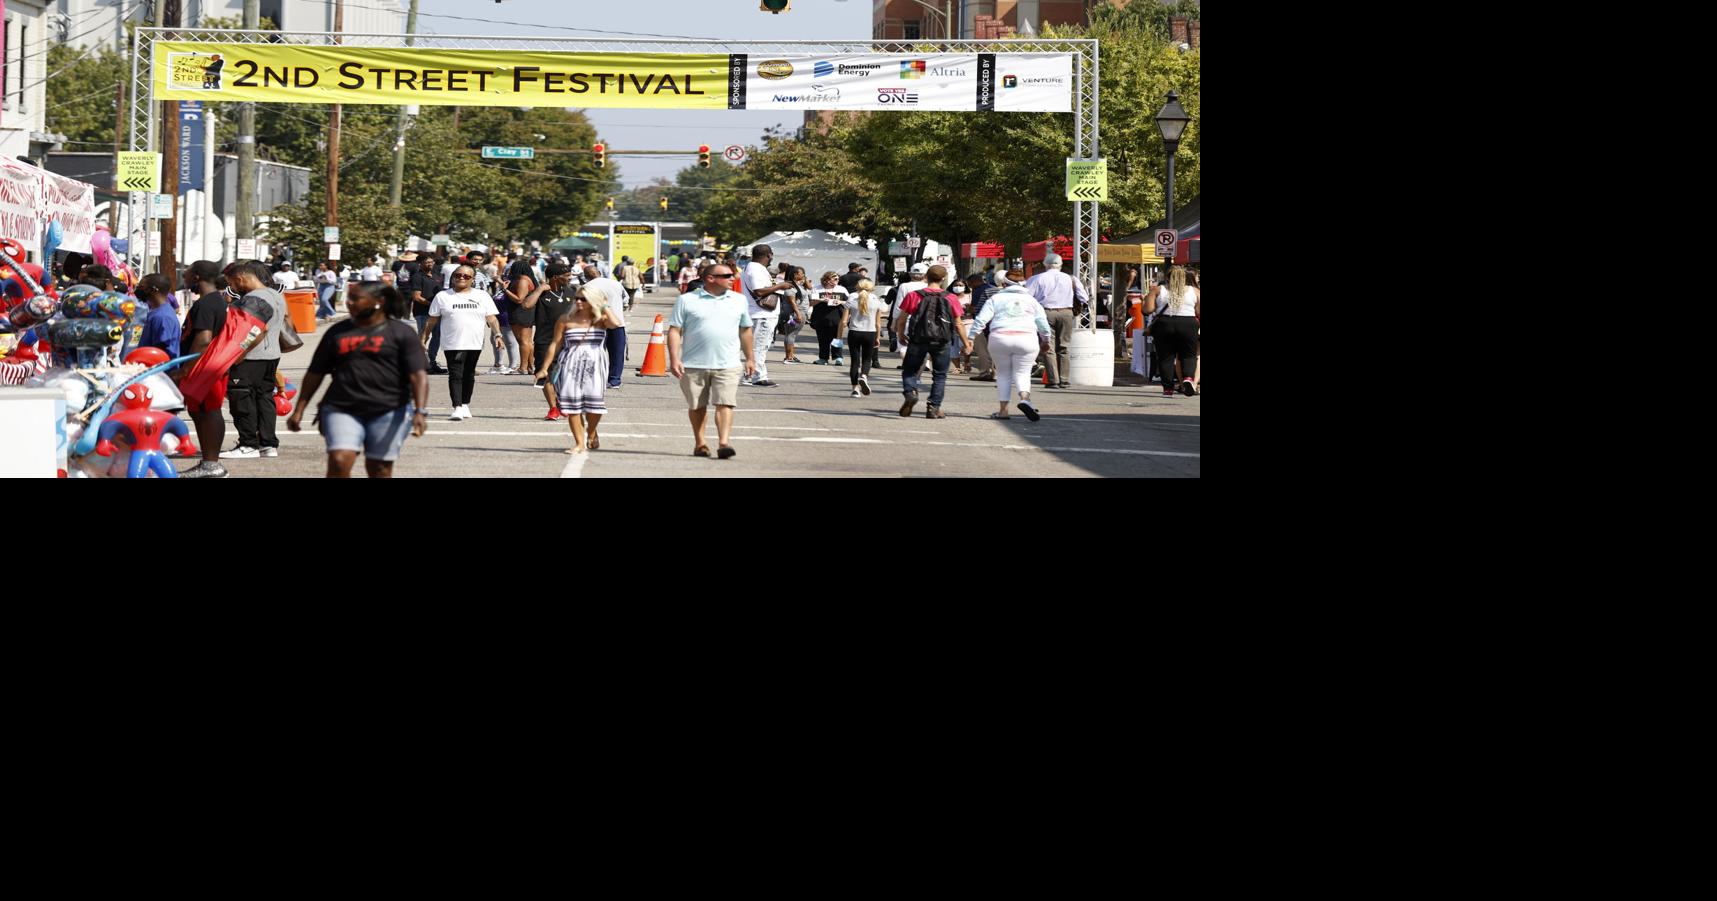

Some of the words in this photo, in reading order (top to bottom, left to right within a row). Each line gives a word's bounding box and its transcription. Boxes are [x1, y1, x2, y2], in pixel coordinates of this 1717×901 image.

[173, 65, 197, 73] 2ND
[982, 59, 990, 68] BY
[232, 60, 319, 88] 2ND
[337, 62, 494, 92] STREET
[513, 66, 705, 95] FESTIVAL
[930, 67, 966, 77] Altria
[733, 67, 741, 105] SPONSORED
[981, 69, 990, 105] PRODUCED
[772, 94, 841, 103] NewMarket
[877, 93, 919, 103] ONE
[182, 125, 191, 146] WARD
[181, 149, 191, 184] JACKSON
